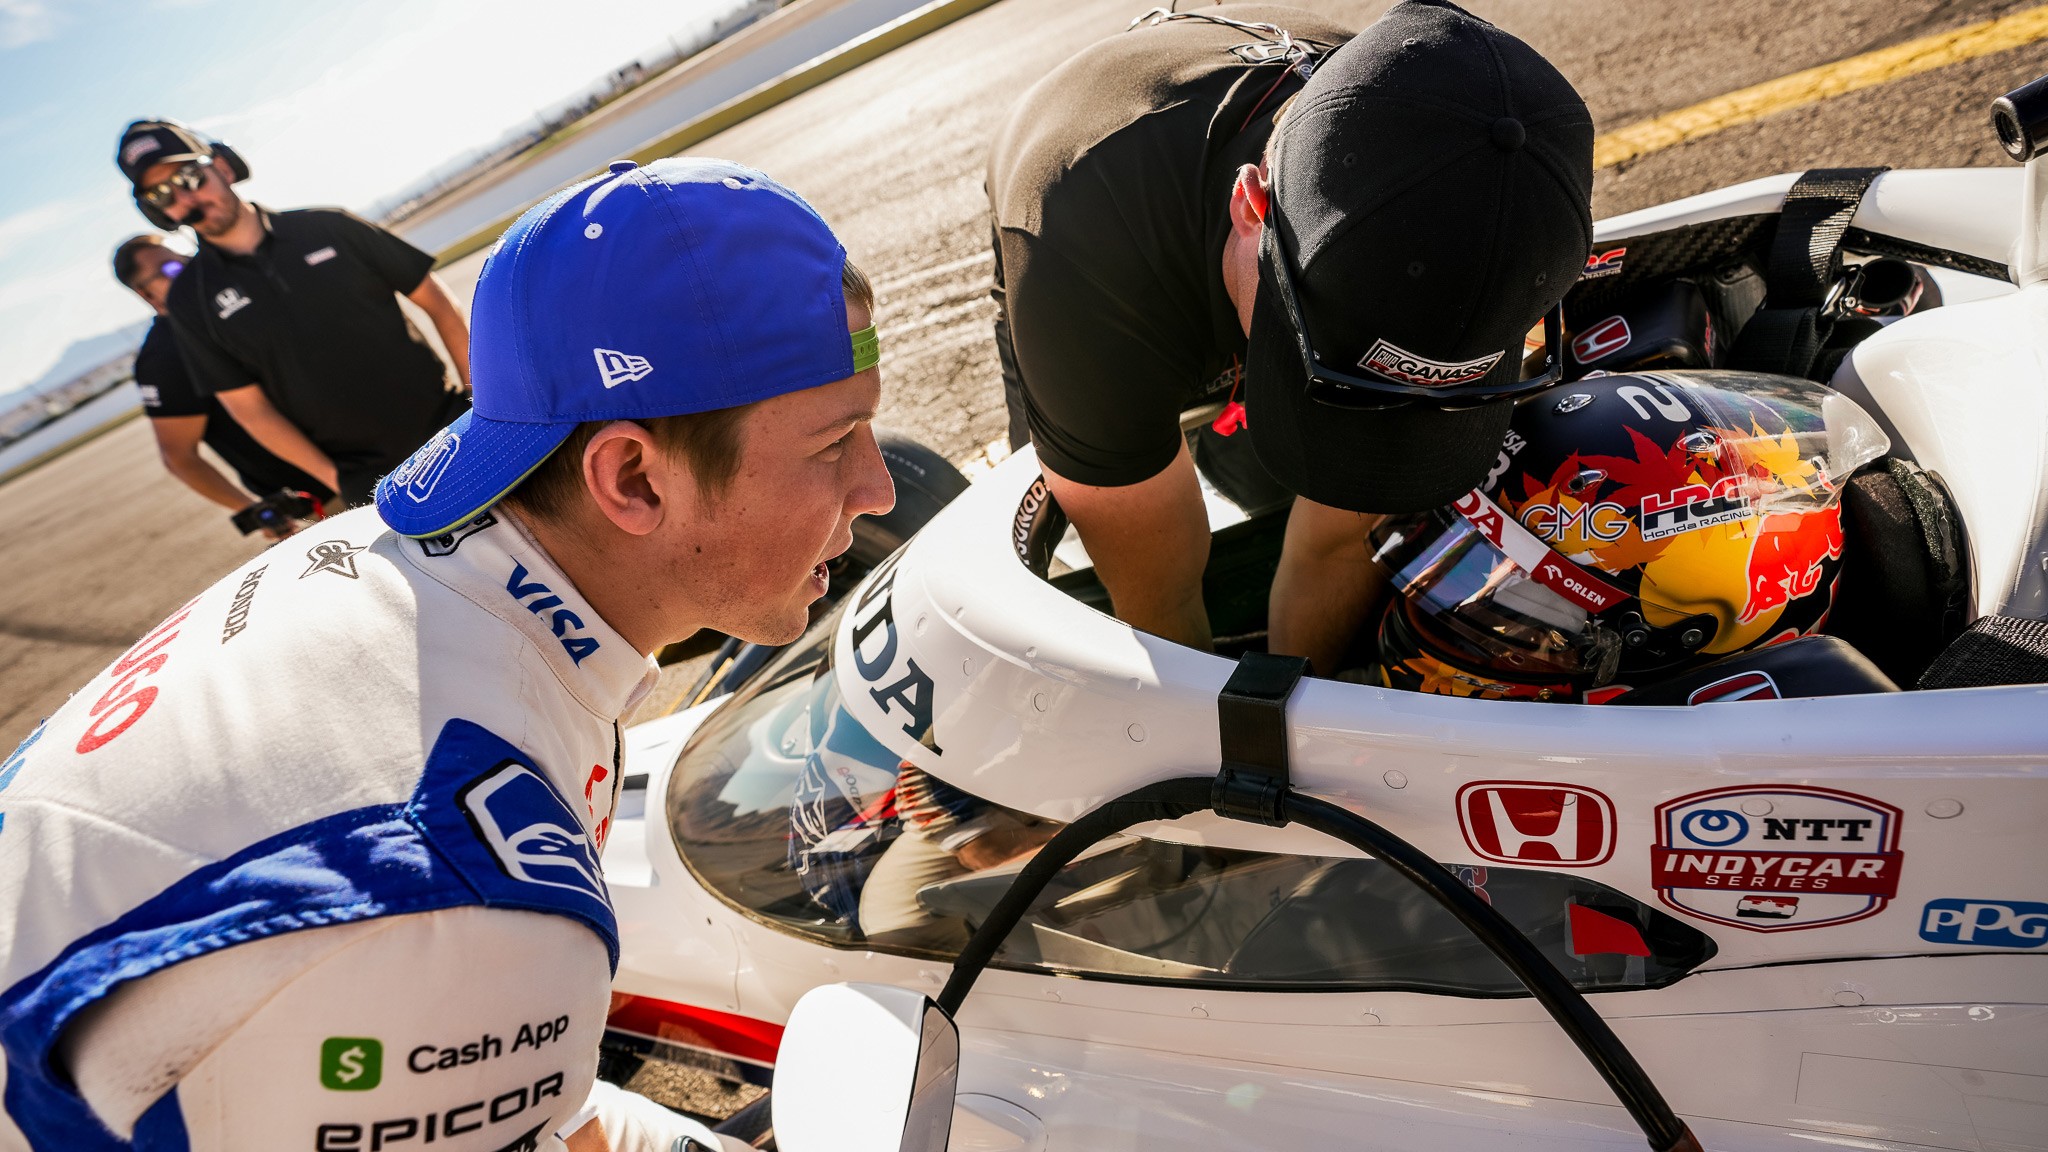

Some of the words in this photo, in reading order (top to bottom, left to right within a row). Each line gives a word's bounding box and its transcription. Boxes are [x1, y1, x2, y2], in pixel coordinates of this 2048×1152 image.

[1583, 247, 1627, 276] RC
[1375, 350, 1398, 368] CHIP
[1641, 473, 1750, 532] HRC
[1520, 501, 1630, 542] GMG
[1643, 523, 1698, 541] Honda
[1699, 510, 1752, 527] RACING
[221, 563, 270, 645] HONDA
[1563, 577, 1607, 607] ORLEN
[506, 554, 601, 670] VISA
[75, 596, 204, 755] UGO
[1762, 818, 1872, 842] NTT
[1663, 853, 1886, 879] INDYCAR
[1705, 875, 1830, 889] SERIES
[1925, 903, 2048, 942] PPG
[407, 1033, 503, 1075] Cash
[510, 1014, 570, 1054] App
